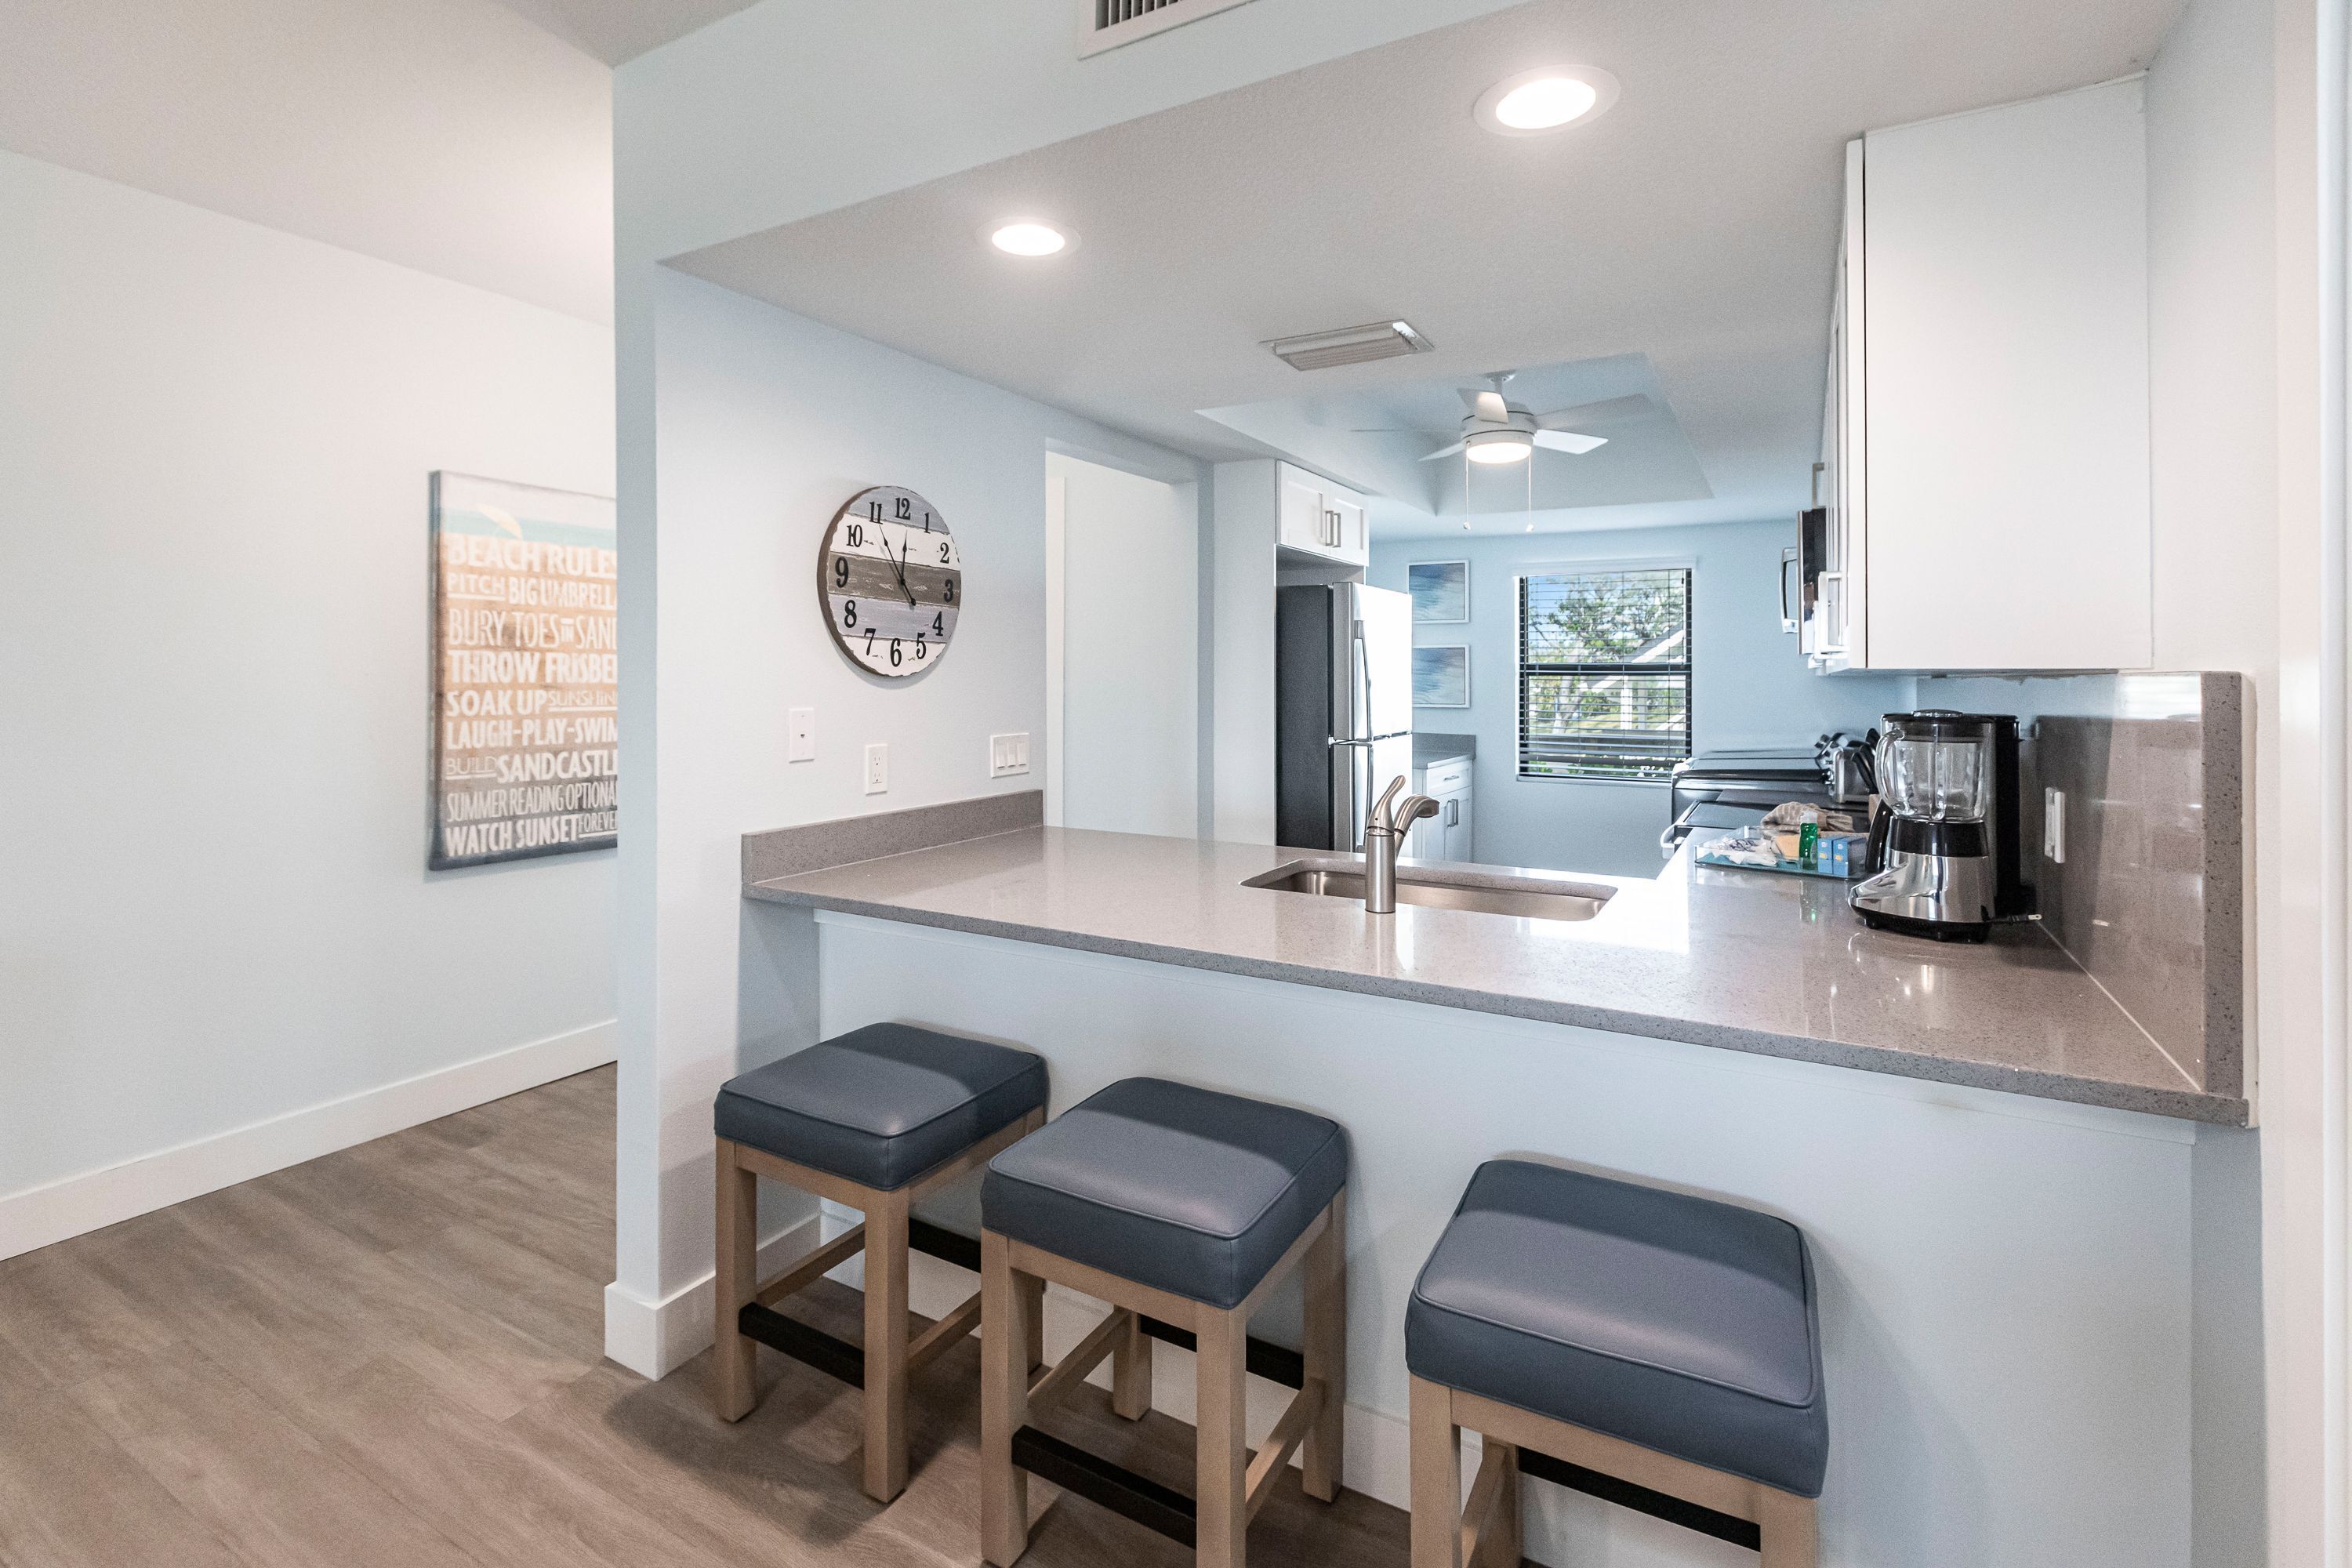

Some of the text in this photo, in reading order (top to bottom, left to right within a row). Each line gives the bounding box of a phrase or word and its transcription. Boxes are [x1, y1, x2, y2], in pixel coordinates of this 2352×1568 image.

[869, 501, 883, 524] 11
[895, 497, 910, 521] 12
[924, 512, 931, 534] 1
[846, 524, 862, 547] 10
[446, 533, 616, 579] BEACH RULE
[939, 542, 949, 564] 2
[835, 556, 849, 588] 9
[446, 572, 616, 611] PITCH BIG UMBRELL
[943, 579, 954, 603] 3
[844, 599, 857, 628] 8
[931, 611, 944, 637] 4
[448, 608, 506, 647] BURY
[511, 611, 561, 649] TOES
[863, 627, 877, 655] 7
[890, 637, 902, 667] 6
[916, 632, 927, 659] 5
[446, 649, 541, 684] THROW
[446, 689, 514, 717] SOAK
[516, 689, 548, 716] UP
[445, 756, 497, 775] BUILD
[447, 789, 509, 822] SUMMER
[510, 784, 564, 816] READING
[445, 820, 513, 857] WATCH
[516, 814, 579, 848] SUNSET
